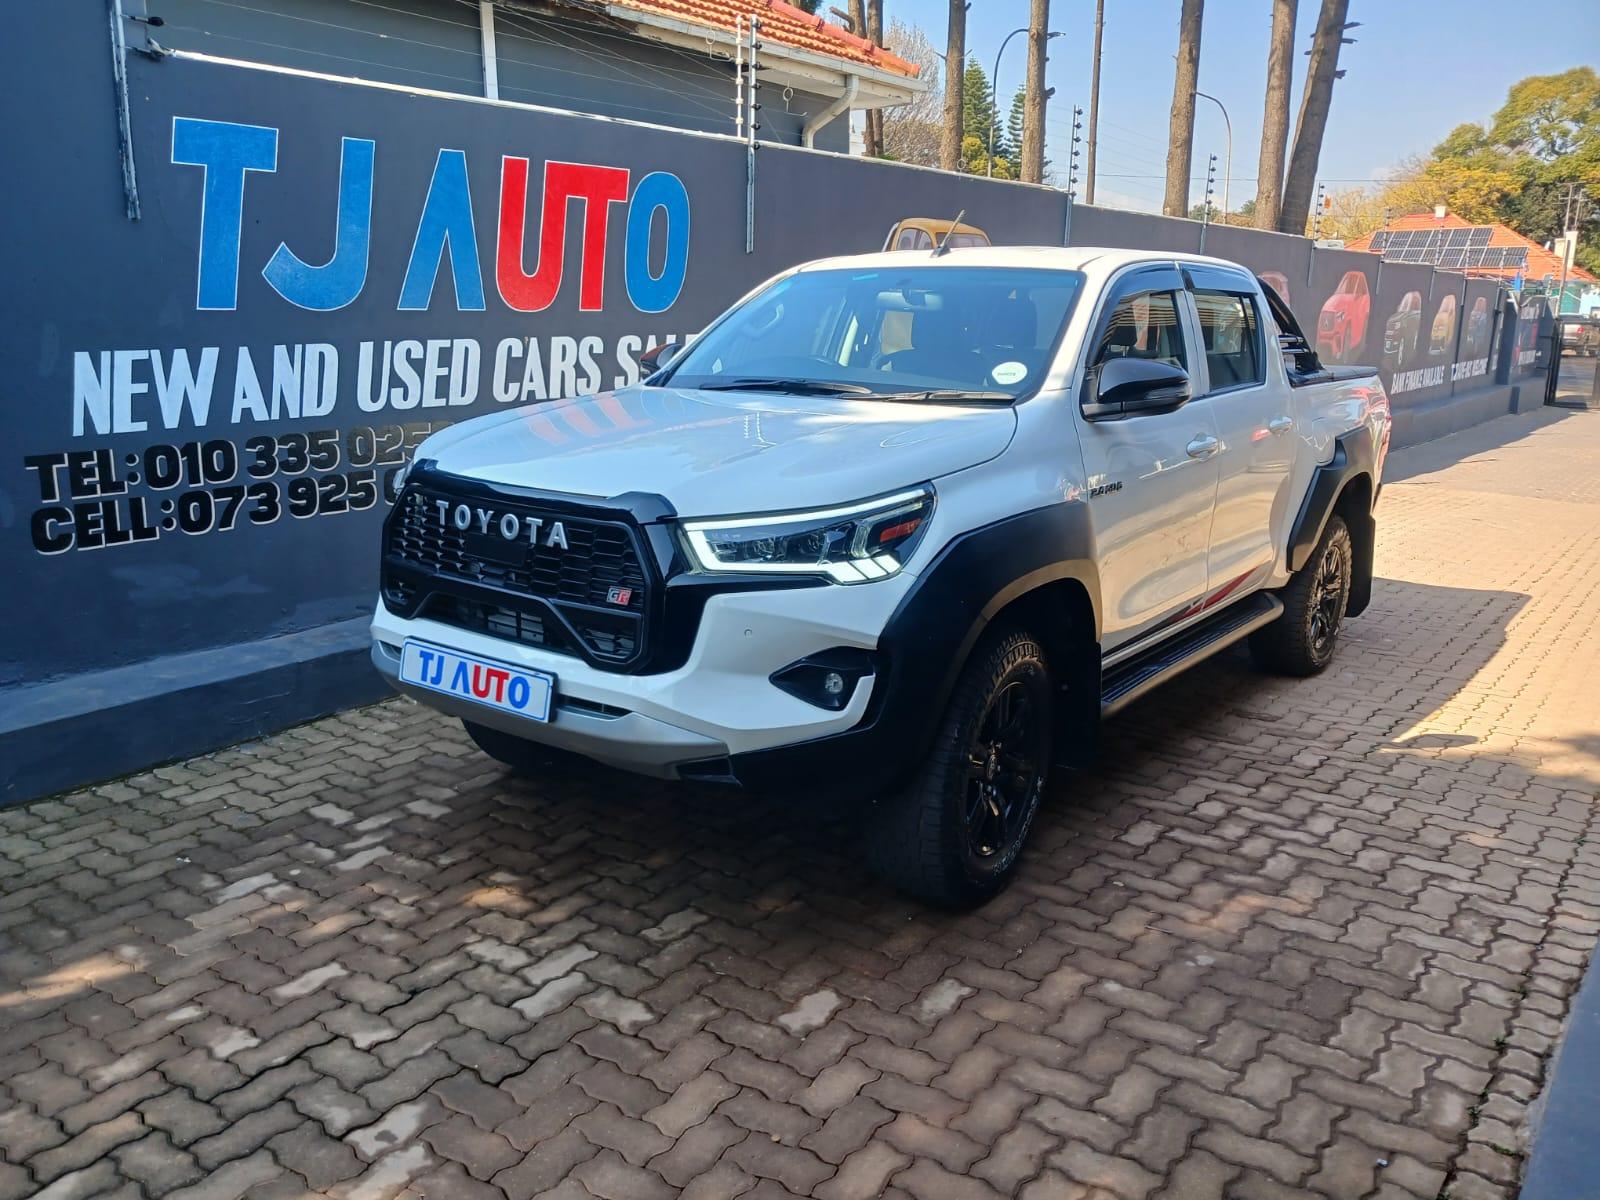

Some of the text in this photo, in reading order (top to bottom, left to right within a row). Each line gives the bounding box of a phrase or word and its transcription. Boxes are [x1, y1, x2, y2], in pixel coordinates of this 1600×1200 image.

[171, 116, 691, 314] TJ AUTO
[72, 346, 218, 437] NEW
[231, 343, 339, 424] AND
[357, 339, 481, 412] USED
[493, 336, 603, 402] CARS
[246, 430, 343, 480] 335
[288, 472, 378, 520] 925
[436, 500, 569, 549] TOYOTA
[418, 651, 530, 709] TJ AUTO
